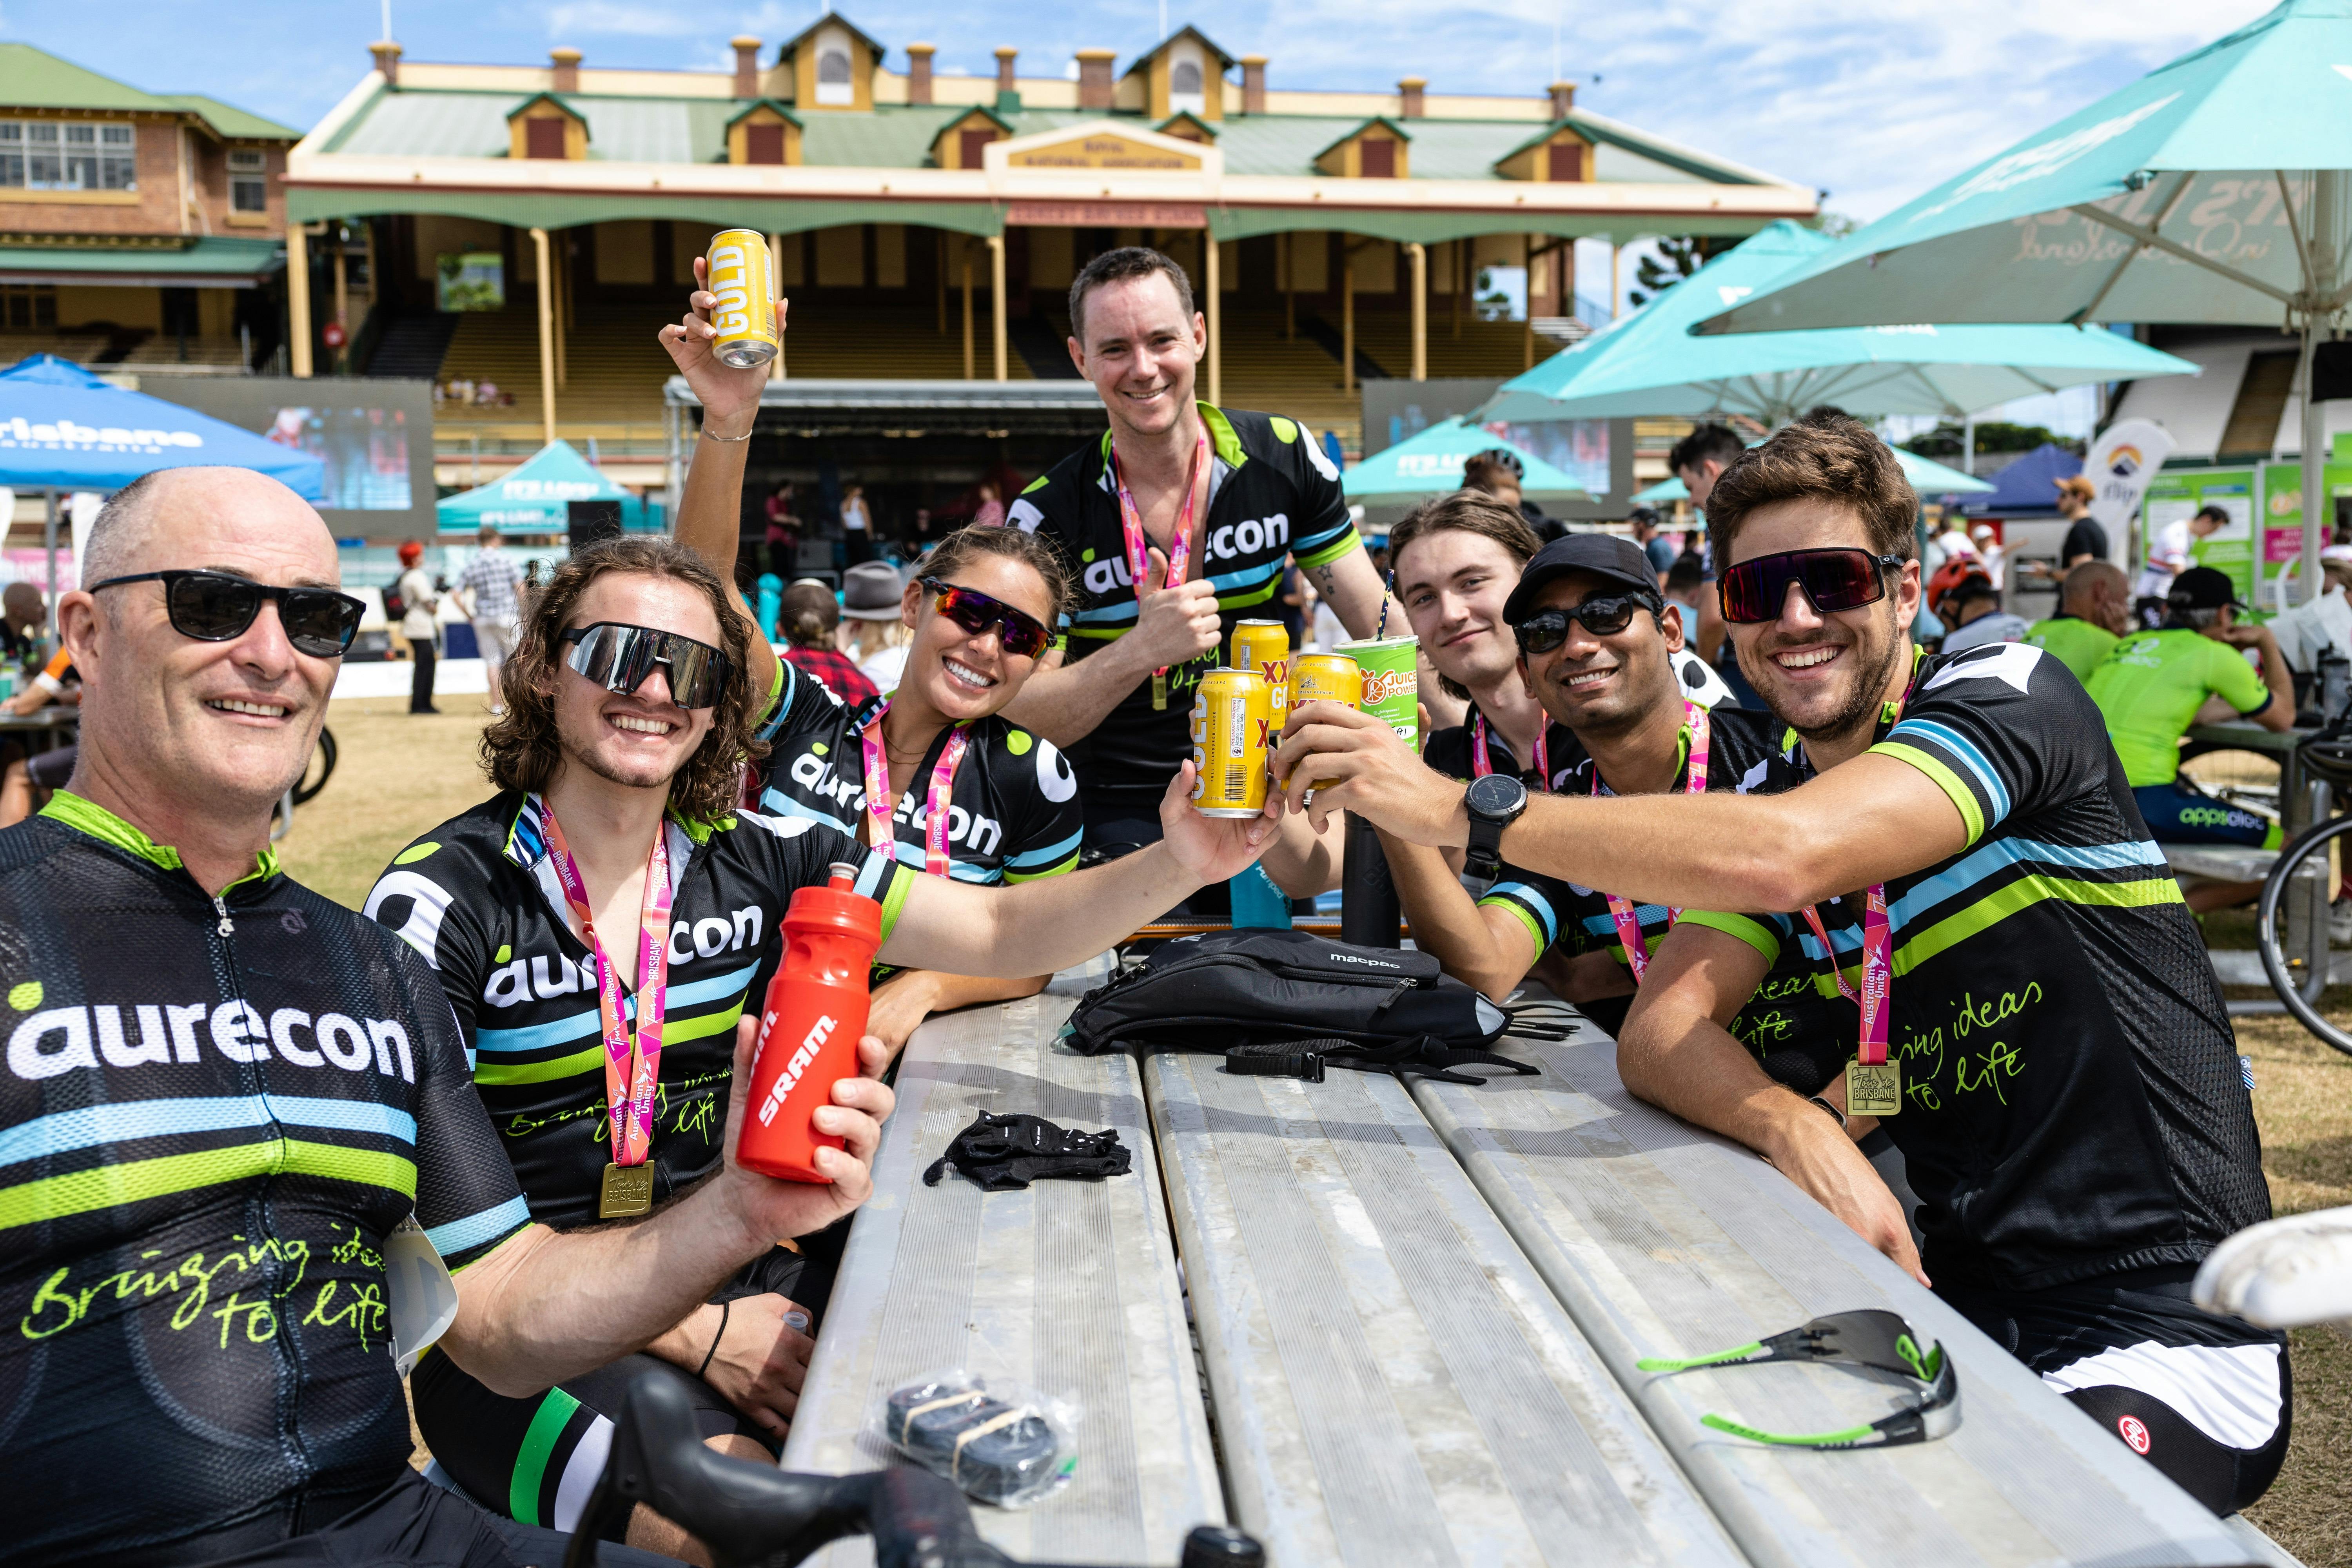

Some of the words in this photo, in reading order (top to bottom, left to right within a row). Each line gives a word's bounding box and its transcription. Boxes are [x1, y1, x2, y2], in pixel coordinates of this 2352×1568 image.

[712, 246, 749, 338] GOLD
[1388, 671, 1416, 686] JUICE
[1388, 684, 1417, 697] POWER
[870, 753, 880, 781] BRISBANE
[933, 817, 943, 850] BRISBANE
[553, 849, 577, 891] BRISBANE
[648, 860, 662, 909] Australian
[483, 905, 763, 1008] aurcon
[648, 938, 661, 980] BRISBANE
[1330, 953, 1401, 969] macpac
[603, 961, 617, 1004] BRISBANE
[647, 985, 659, 998] de
[1864, 968, 1875, 1025] Australian
[1875, 970, 1888, 998] Unity
[609, 1008, 620, 1021] de
[644, 1002, 659, 1027] Tour
[1952, 982, 2043, 1041] ideas
[7, 998, 415, 1085] aurecon
[610, 1024, 625, 1051] Tour
[758, 1015, 835, 1128] SRAM
[1853, 1074, 1879, 1089] Tour
[1881, 1076, 1895, 1087] de
[1906, 1076, 1941, 1111] to
[1955, 1042, 2025, 1105] life
[641, 1085, 655, 1114] Unity
[1854, 1087, 1895, 1099] BRISBANE
[630, 1084, 644, 1141] Australian
[671, 1092, 716, 1145] life
[608, 1188, 647, 1201] BRISBANE
[609, 1177, 633, 1191] Tour
[21, 1234, 309, 1339] Bringing
[212, 1292, 278, 1349] to
[302, 1279, 388, 1354] life
